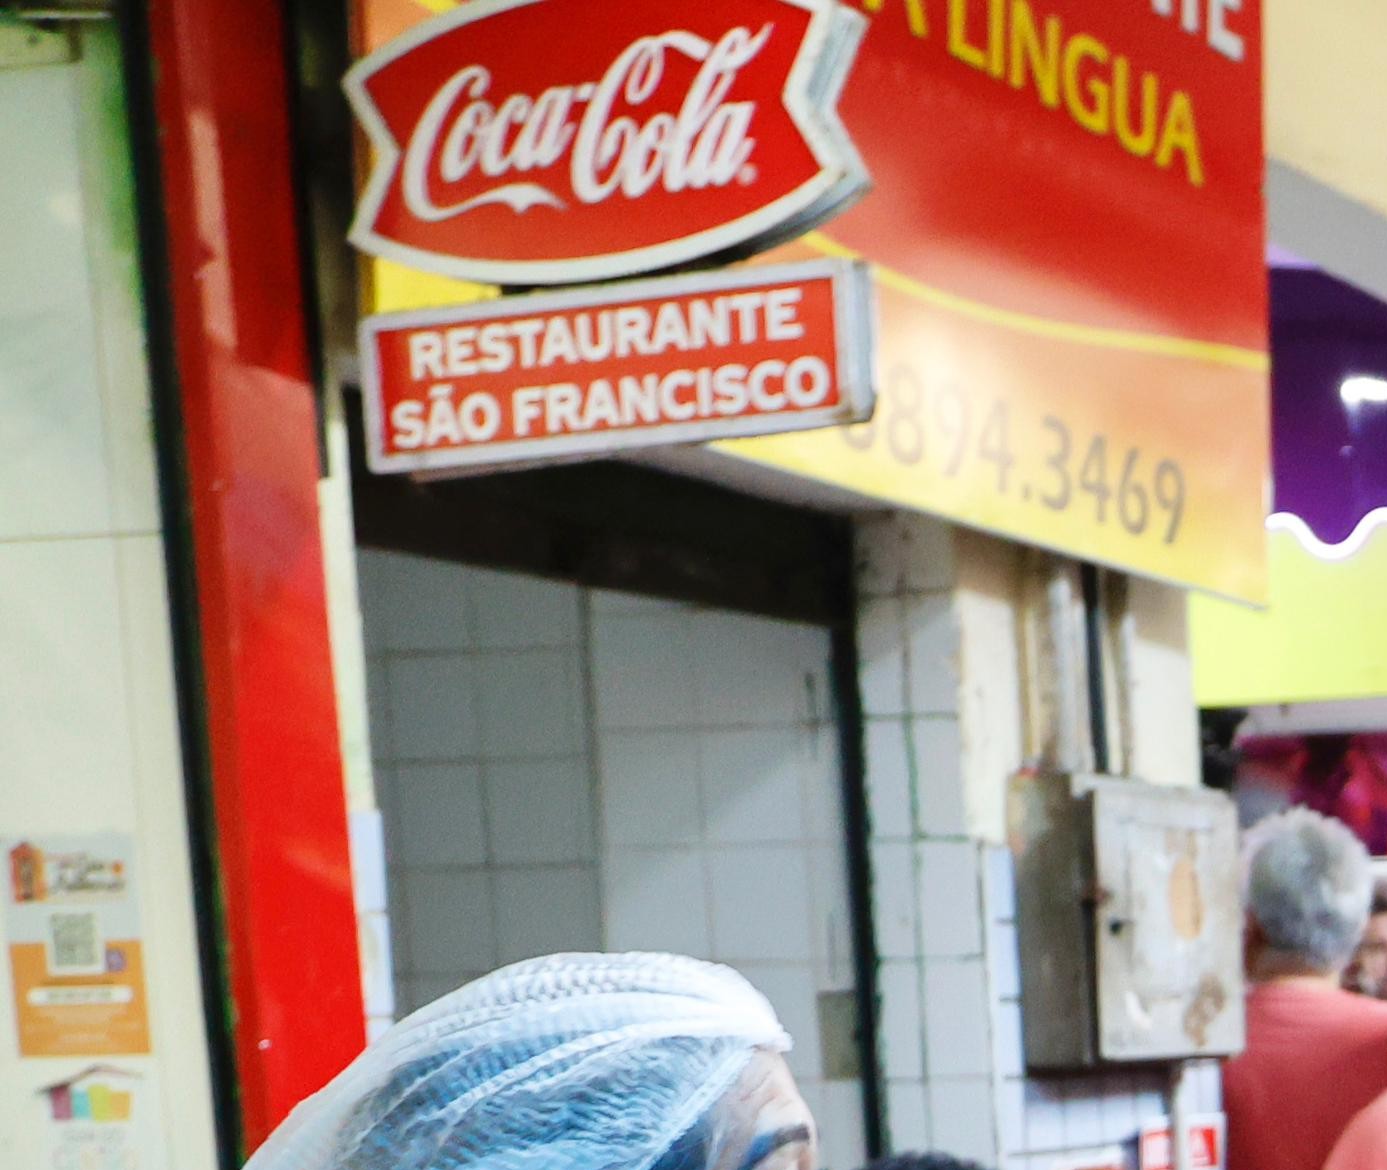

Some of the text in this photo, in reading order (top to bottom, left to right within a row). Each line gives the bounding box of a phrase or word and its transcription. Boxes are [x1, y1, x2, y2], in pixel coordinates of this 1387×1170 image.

[403, 22, 774, 221] Coca-Cola
[390, 356, 831, 449] SÃO FRANCISCO
[407, 289, 805, 382] RESTAURANTE
[840, 363, 1185, 545] 894.3469
